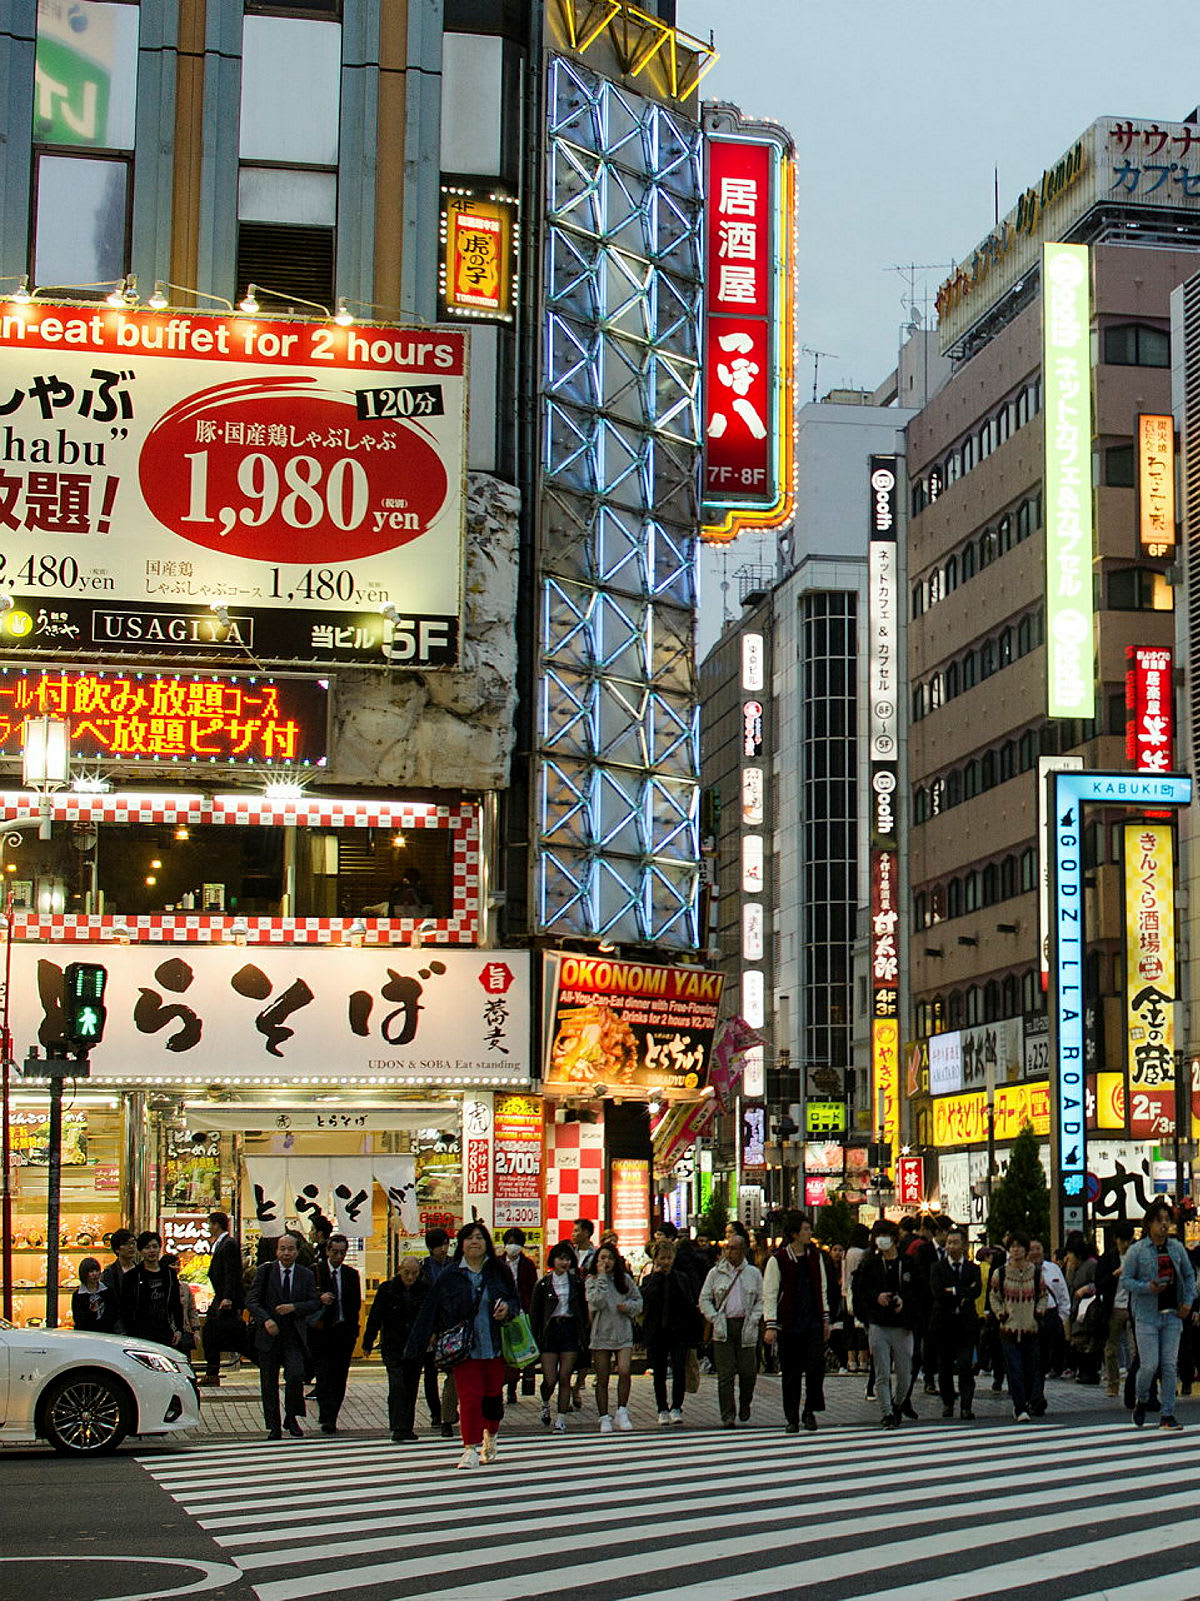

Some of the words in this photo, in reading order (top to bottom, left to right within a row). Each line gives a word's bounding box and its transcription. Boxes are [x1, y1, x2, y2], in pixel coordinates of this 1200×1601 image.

[451, 200, 475, 212] 4F
[463, 235, 489, 285] 虎の子
[717, 177, 758, 305] 居酒屋
[117, 315, 230, 354] buffet
[243, 323, 299, 356] for
[311, 329, 335, 360] 2
[347, 326, 454, 367] hours
[363, 388, 437, 418] 120分
[707, 332, 767, 440] つぼ八
[180, 450, 369, 536] 1,980
[871, 469, 895, 531] Booth
[372, 509, 420, 533] yen
[146, 560, 194, 577] 国産鶏
[1148, 544, 1168, 558] 6F
[79, 575, 116, 592] yen
[146, 577, 263, 599] しゃぶしゃぶコース
[269, 568, 354, 603] 1,480
[354, 587, 390, 604] yen
[877, 549, 890, 621] ネットカフェ
[105, 616, 246, 642] USAGIYA
[311, 624, 375, 650] 当ビル
[381, 619, 448, 660] 5F
[879, 627, 889, 639] &
[877, 644, 891, 692] カプセル
[872, 771, 897, 833] Booth
[1139, 832, 1160, 953] きんくら酒場
[1060, 835, 1080, 1024] GODZILLA
[488, 965, 506, 990] 旨
[562, 959, 668, 994] OKONOMI
[674, 971, 723, 999] YAKI
[876, 989, 897, 1003] 4F
[560, 991, 625, 1007] All-You-Can-Eat
[622, 1010, 649, 1024] Drinks
[649, 1013, 661, 1024] for
[661, 1014, 666, 1025] 2
[668, 1015, 691, 1028] hours
[875, 1003, 897, 1016] 3F
[483, 999, 509, 1055] 蕎麦
[1132, 985, 1176, 1086] 金の蔵
[368, 1059, 404, 1070] UDON
[408, 1059, 416, 1070] &
[419, 1059, 451, 1070] SOBA
[455, 1060, 473, 1070] Eat
[476, 1059, 521, 1072] standing
[1062, 1046, 1081, 1136] ROAD
[1132, 1094, 1162, 1120] 2F
[468, 1141, 478, 1193] 280円
[478, 1141, 489, 1193] かけそば
